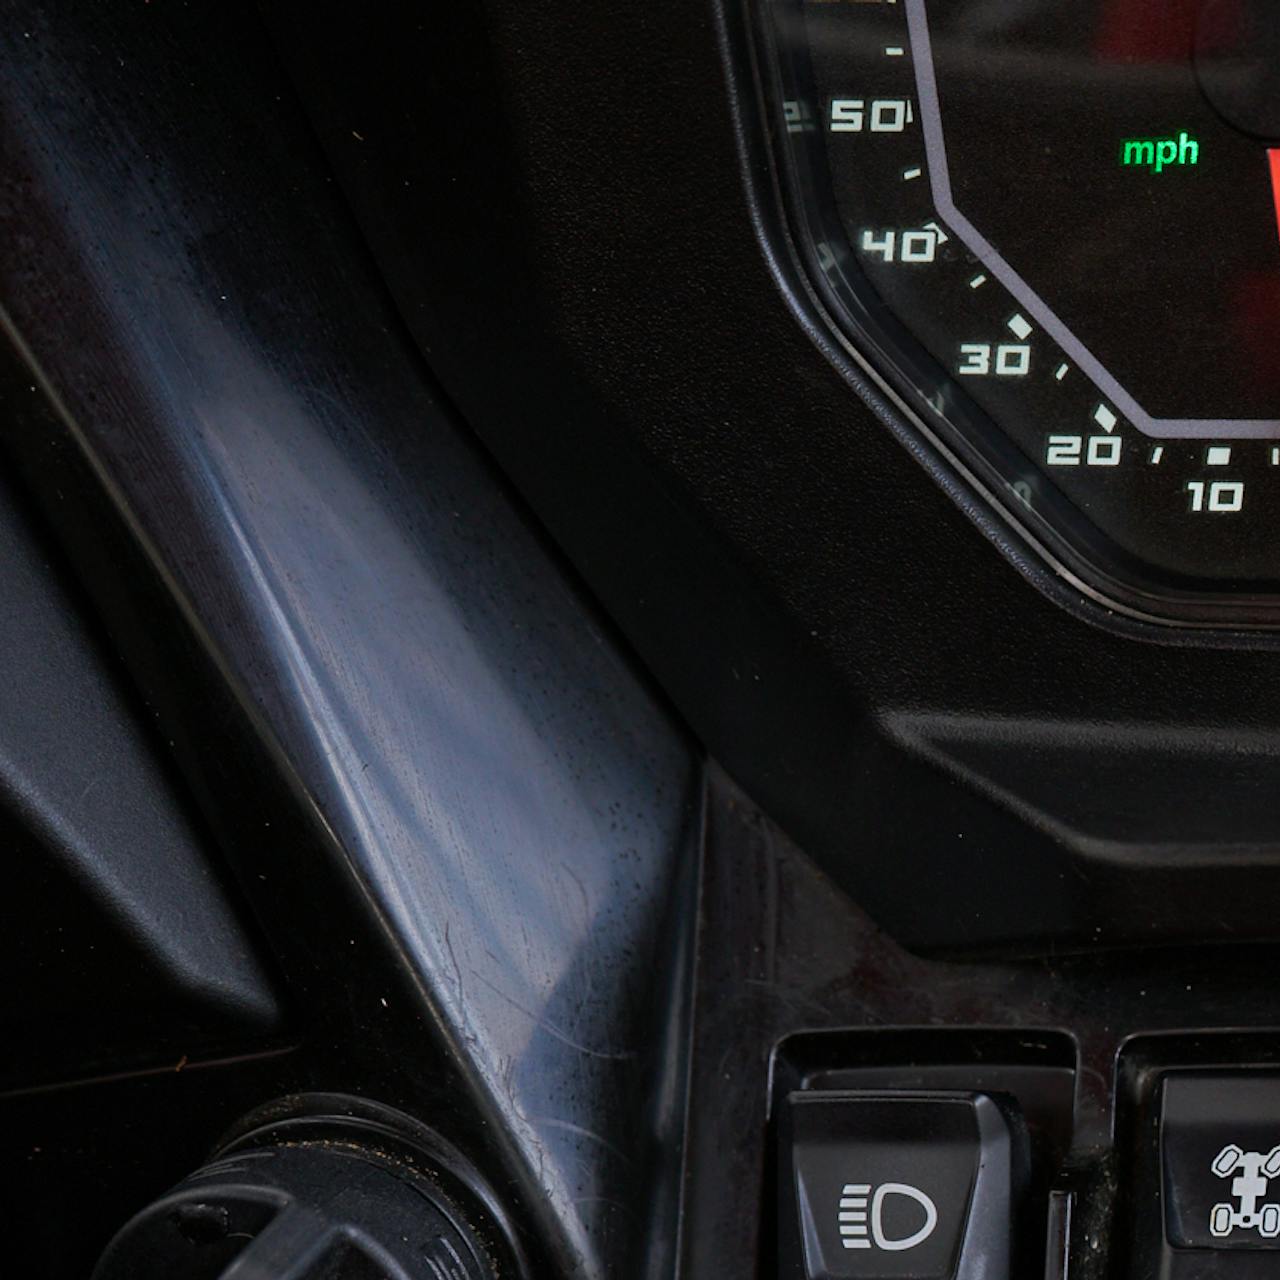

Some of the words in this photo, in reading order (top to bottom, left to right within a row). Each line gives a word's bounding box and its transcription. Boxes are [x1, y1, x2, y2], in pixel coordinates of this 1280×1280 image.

[829, 99, 906, 133] 50
[1122, 132, 1200, 173] mph
[863, 230, 936, 262] 40
[959, 344, 1030, 375] 30
[1047, 436, 1121, 465] 20
[1187, 482, 1244, 512] 10
